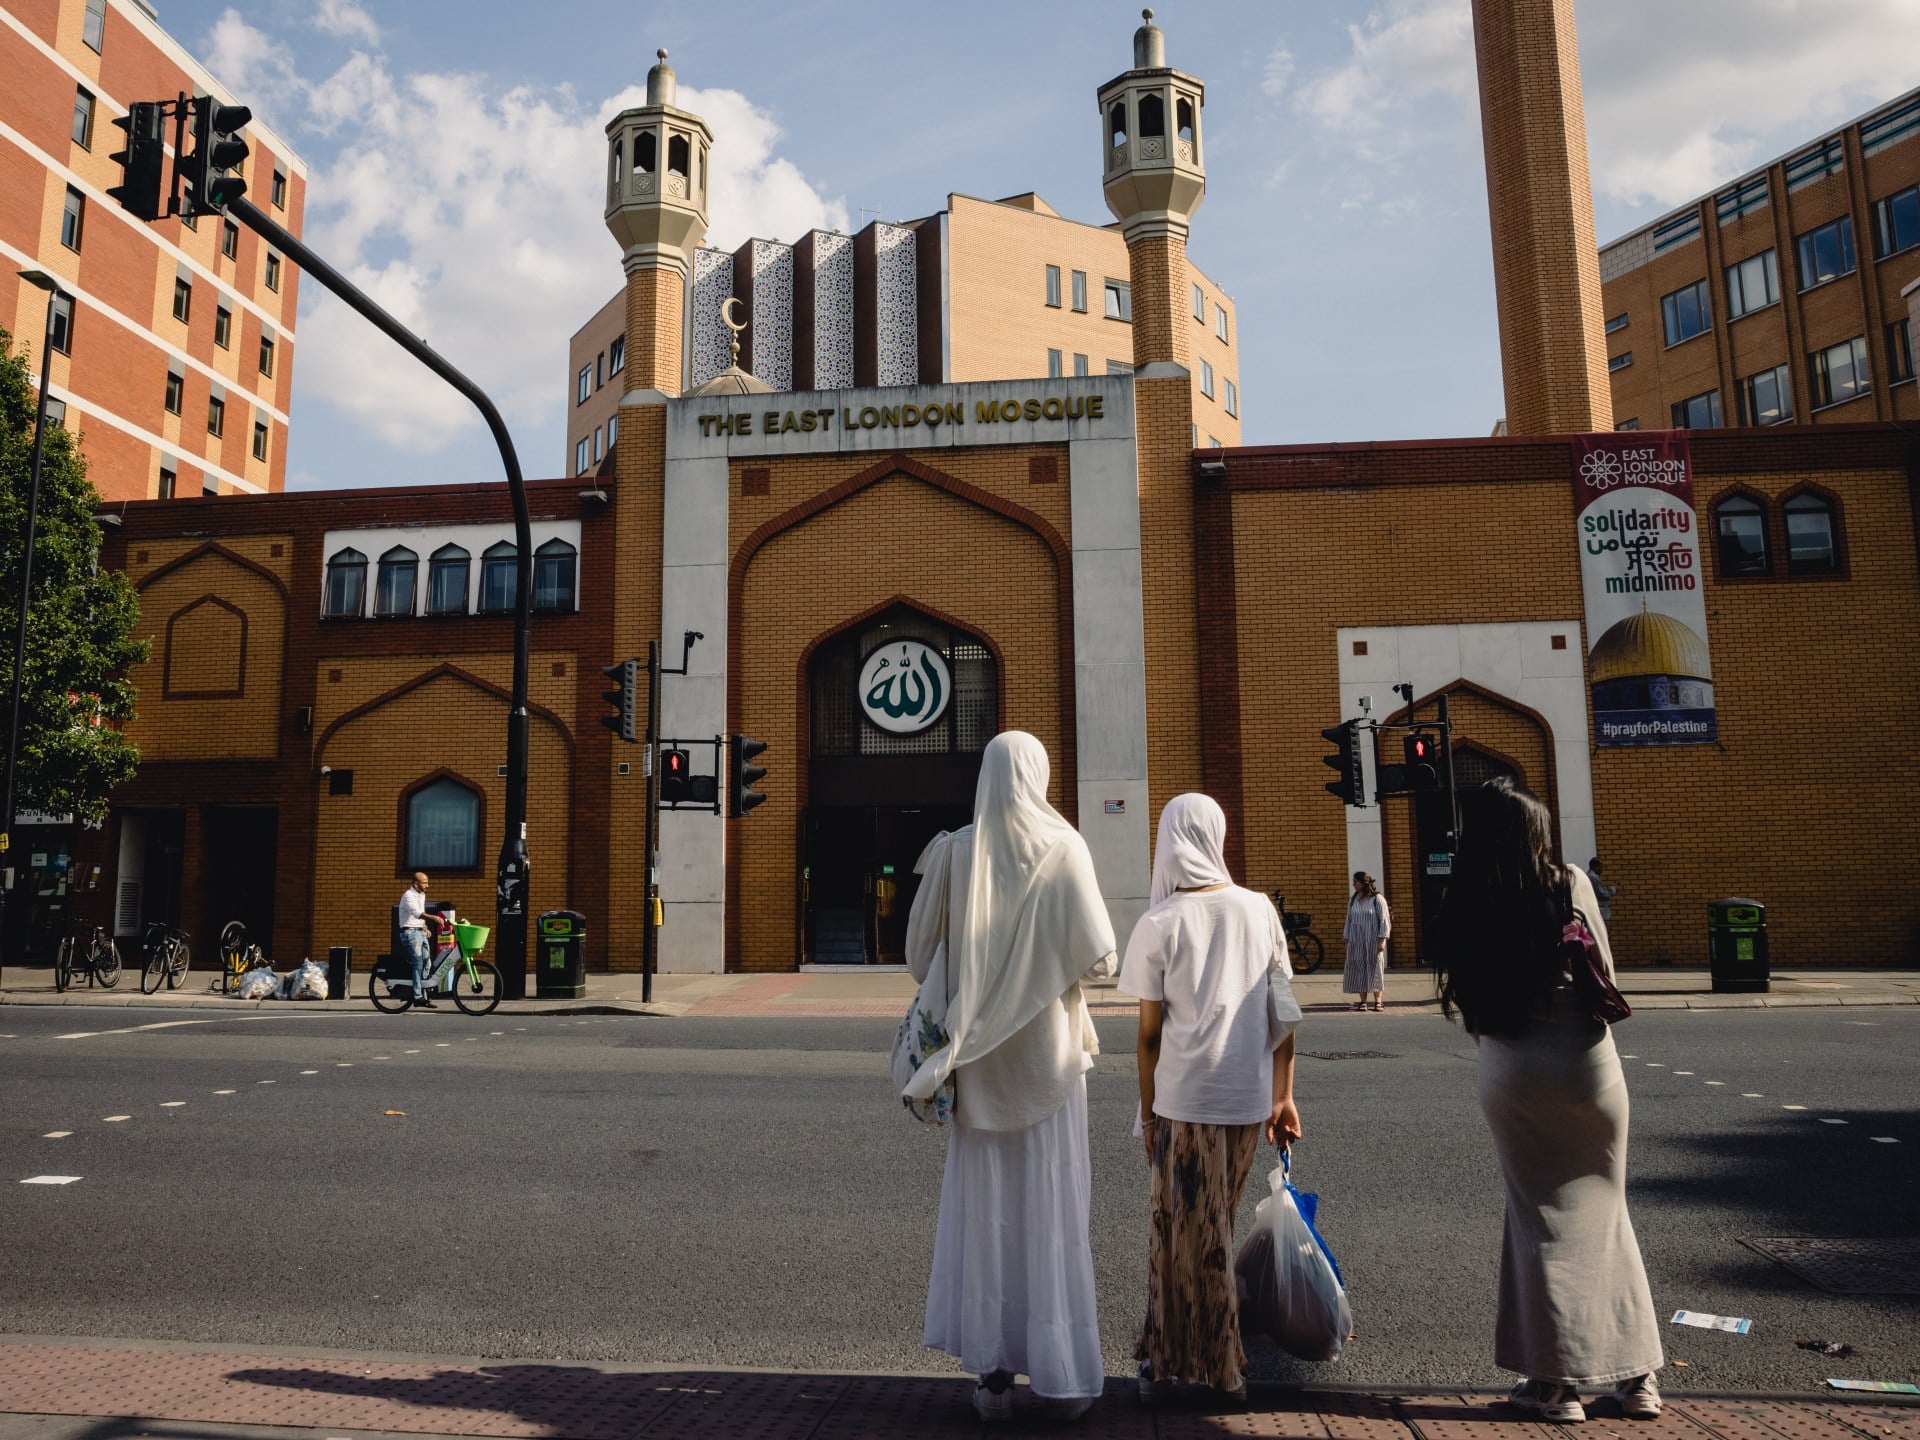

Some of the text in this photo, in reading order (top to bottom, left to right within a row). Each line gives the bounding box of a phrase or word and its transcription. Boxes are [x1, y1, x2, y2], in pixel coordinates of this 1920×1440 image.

[698, 395, 1104, 436] THE EAST LONDON MOSQUE
[1622, 448, 1656, 461] EAST
[1623, 459, 1686, 473] LONDON
[1624, 471, 1687, 485] MOSQUE
[1583, 507, 1690, 533] solidarity
[1605, 572, 1696, 594] midnimo
[1602, 720, 1708, 738] #prayforPalestine
